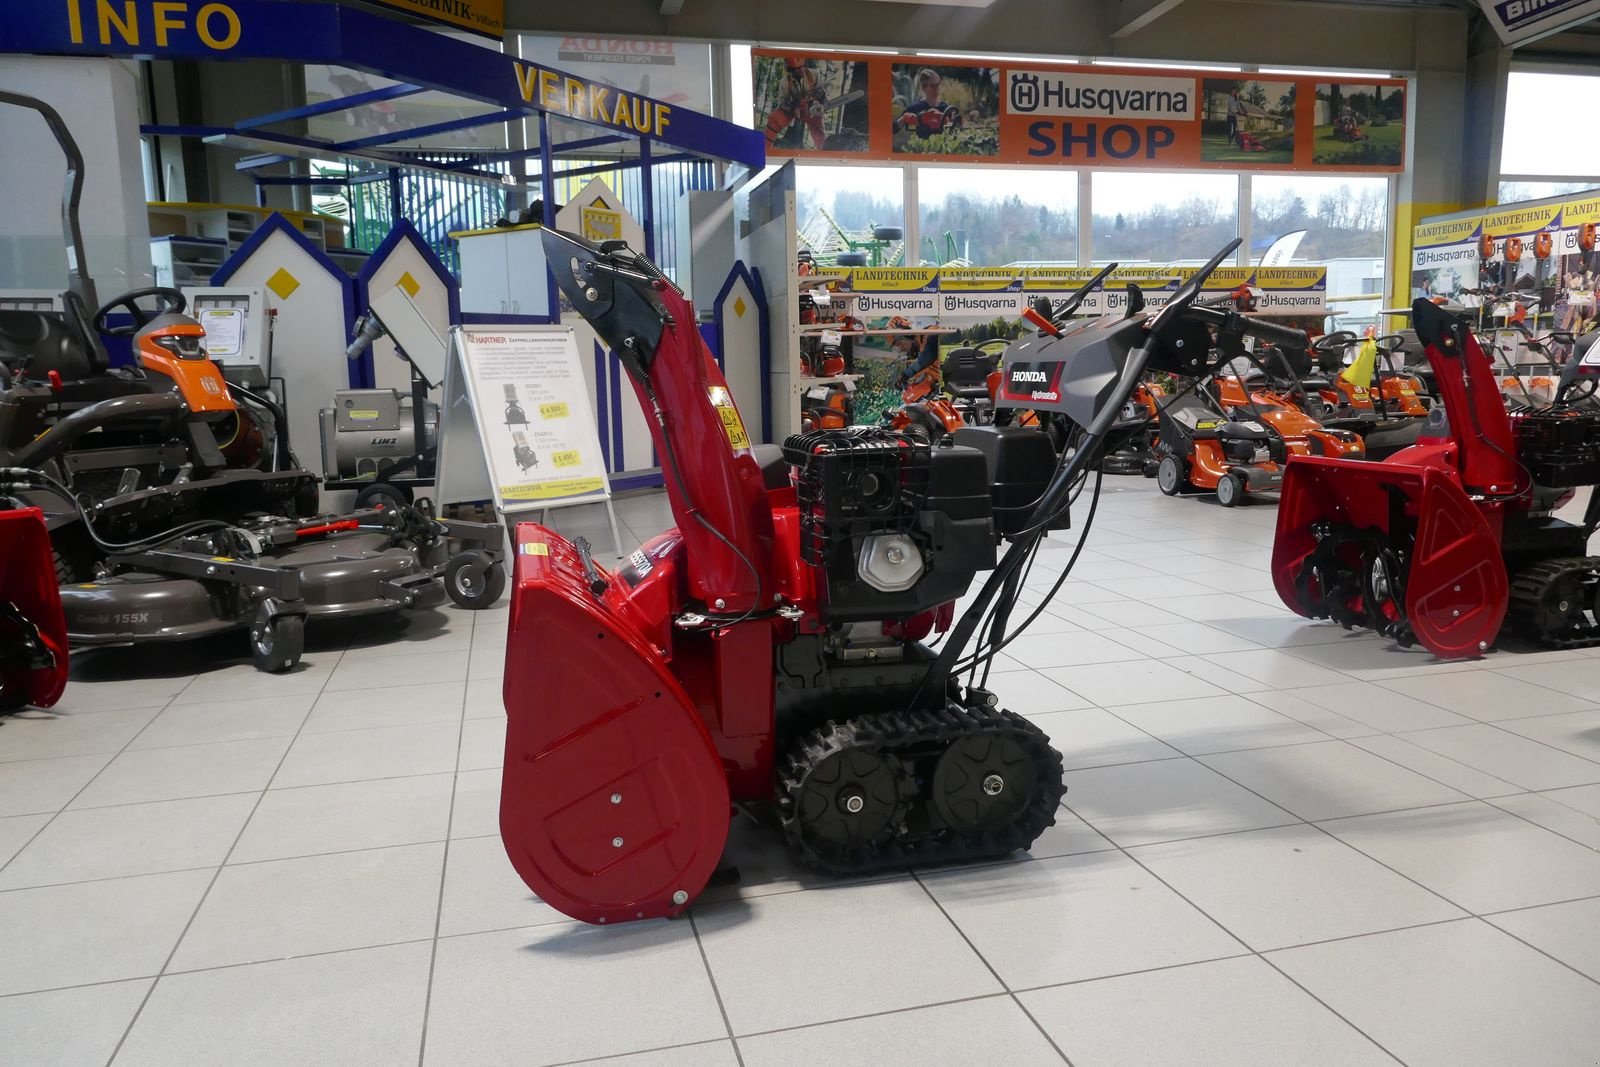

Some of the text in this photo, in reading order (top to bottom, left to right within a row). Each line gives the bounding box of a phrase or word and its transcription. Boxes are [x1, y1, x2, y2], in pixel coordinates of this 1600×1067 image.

[67, 0, 242, 50] INFO
[513, 61, 672, 137] VERKAUF
[1043, 80, 1188, 115] Husqvarna
[1027, 120, 1176, 160] SHOP
[1485, 209, 1551, 228] LANDTECHNIK
[1416, 221, 1473, 238] LANDTECHNIK
[1426, 248, 1475, 263] Husqvarna
[856, 271, 928, 280] LANDTECHNIK
[1259, 270, 1318, 279] LANDTECHNIK
[871, 298, 932, 311] Husqvarna
[957, 298, 1017, 310] Husqvarna
[1270, 296, 1321, 307] Husqvarna
[1012, 371, 1047, 382] HONDA
[113, 612, 149, 623] 155X
